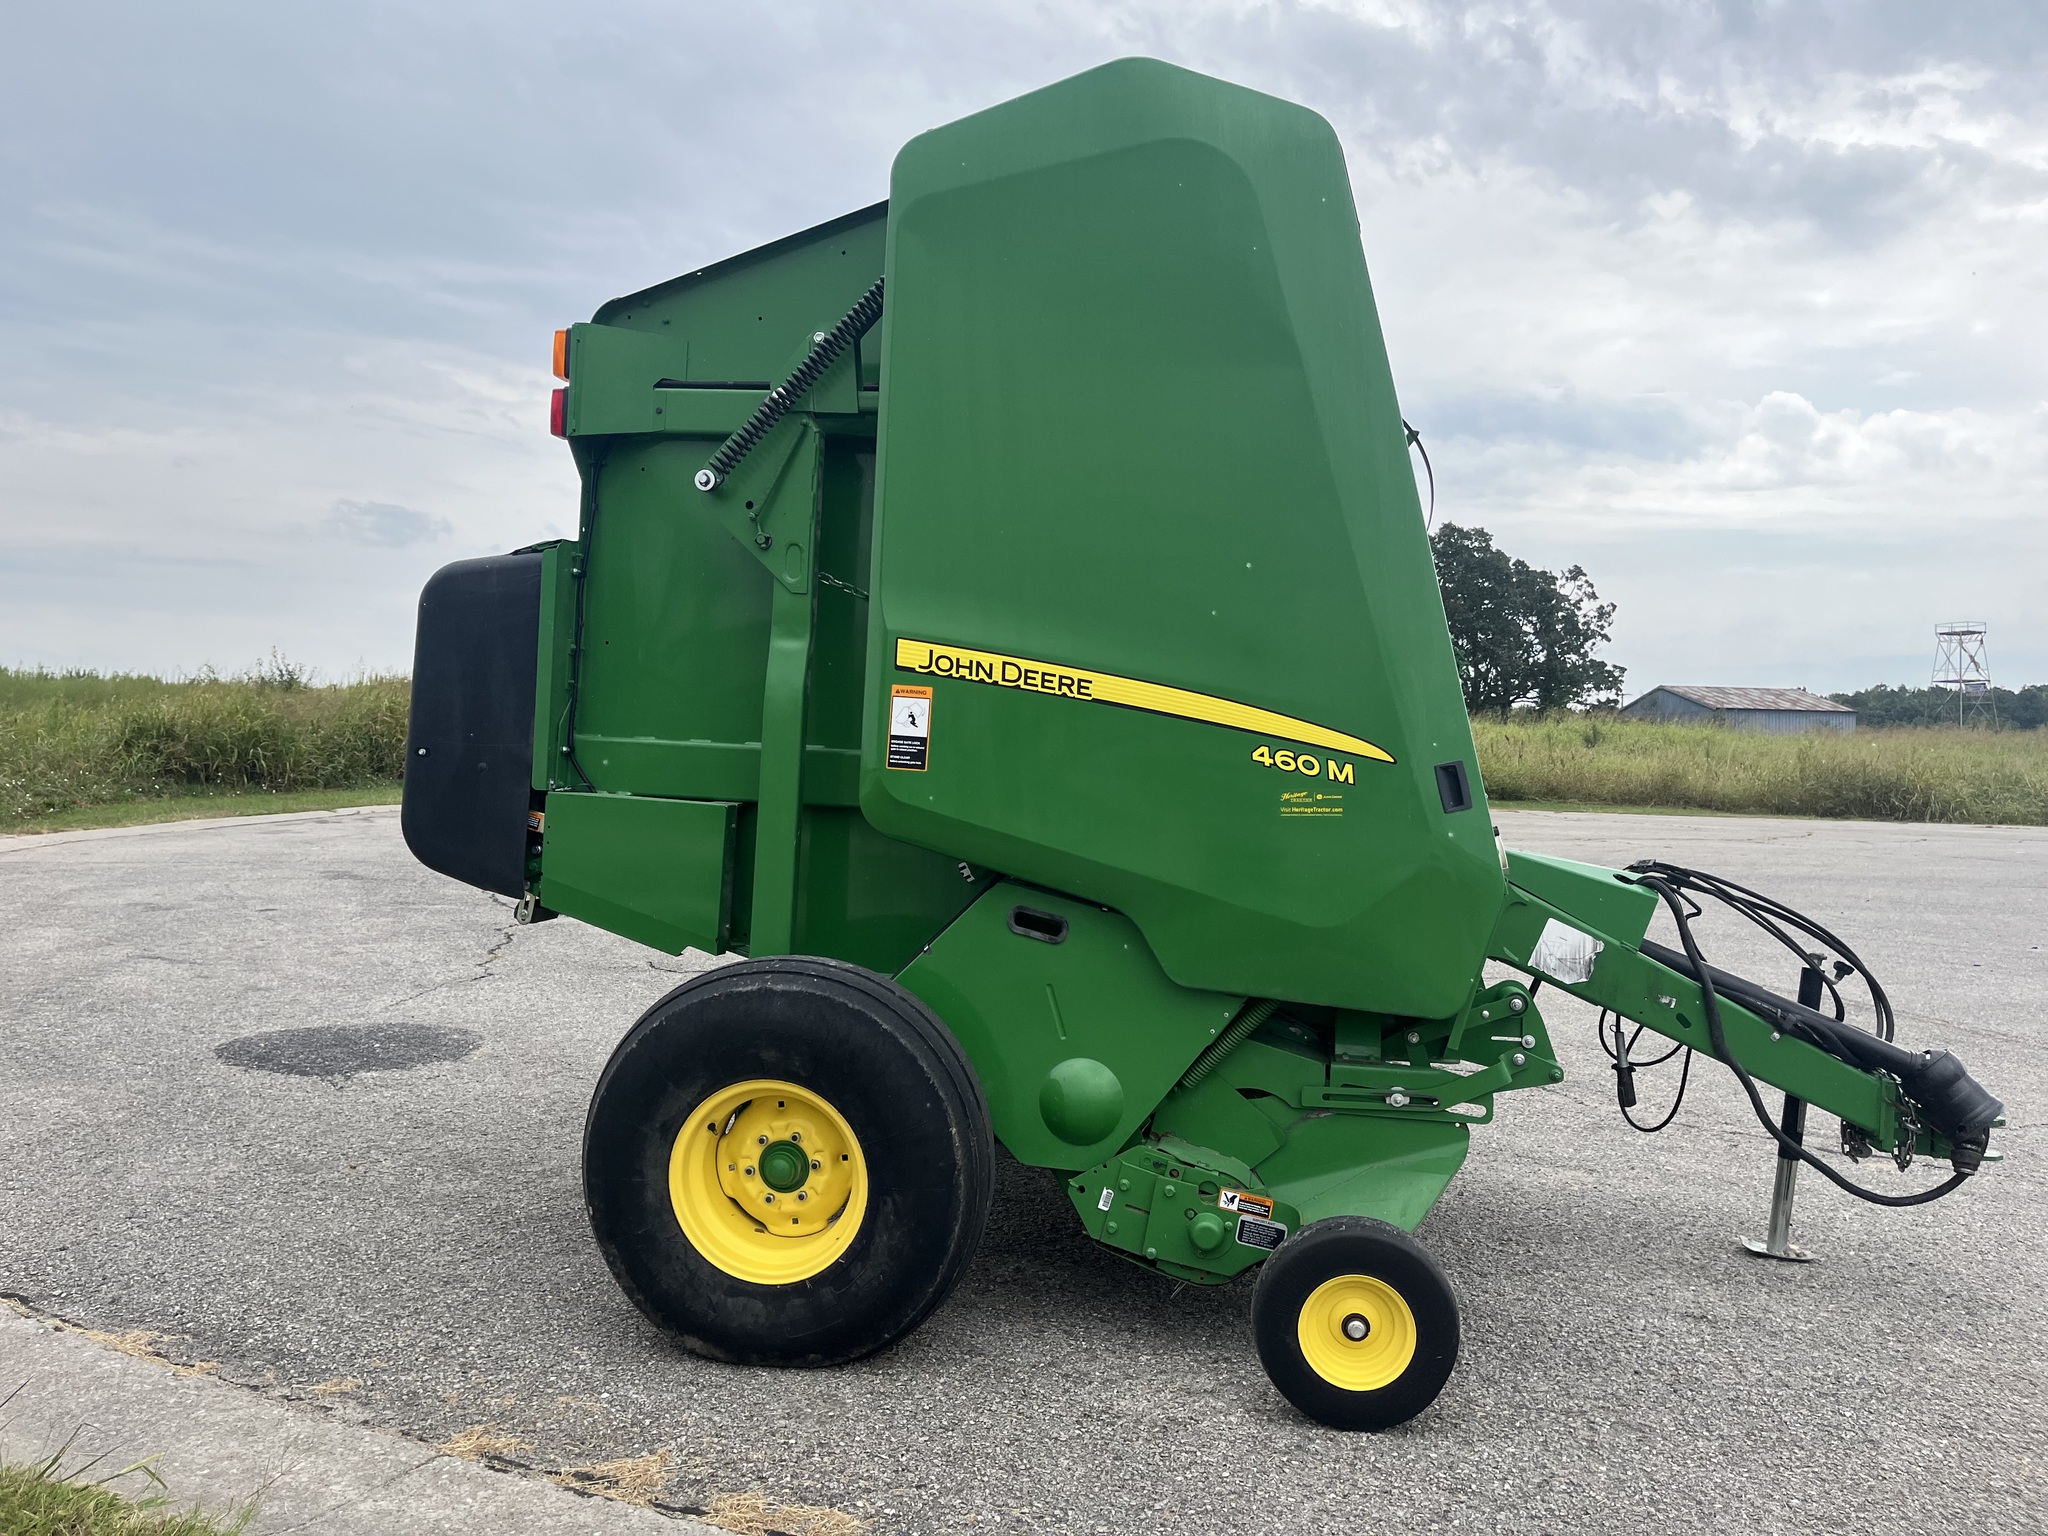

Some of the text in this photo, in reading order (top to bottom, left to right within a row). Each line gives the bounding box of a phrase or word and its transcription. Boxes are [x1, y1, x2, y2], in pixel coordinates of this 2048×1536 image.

[918, 649, 1093, 698] JOHN DEERE
[1251, 745, 1355, 785] 460 M
[1292, 806, 1343, 814] HeritageTractor.com
